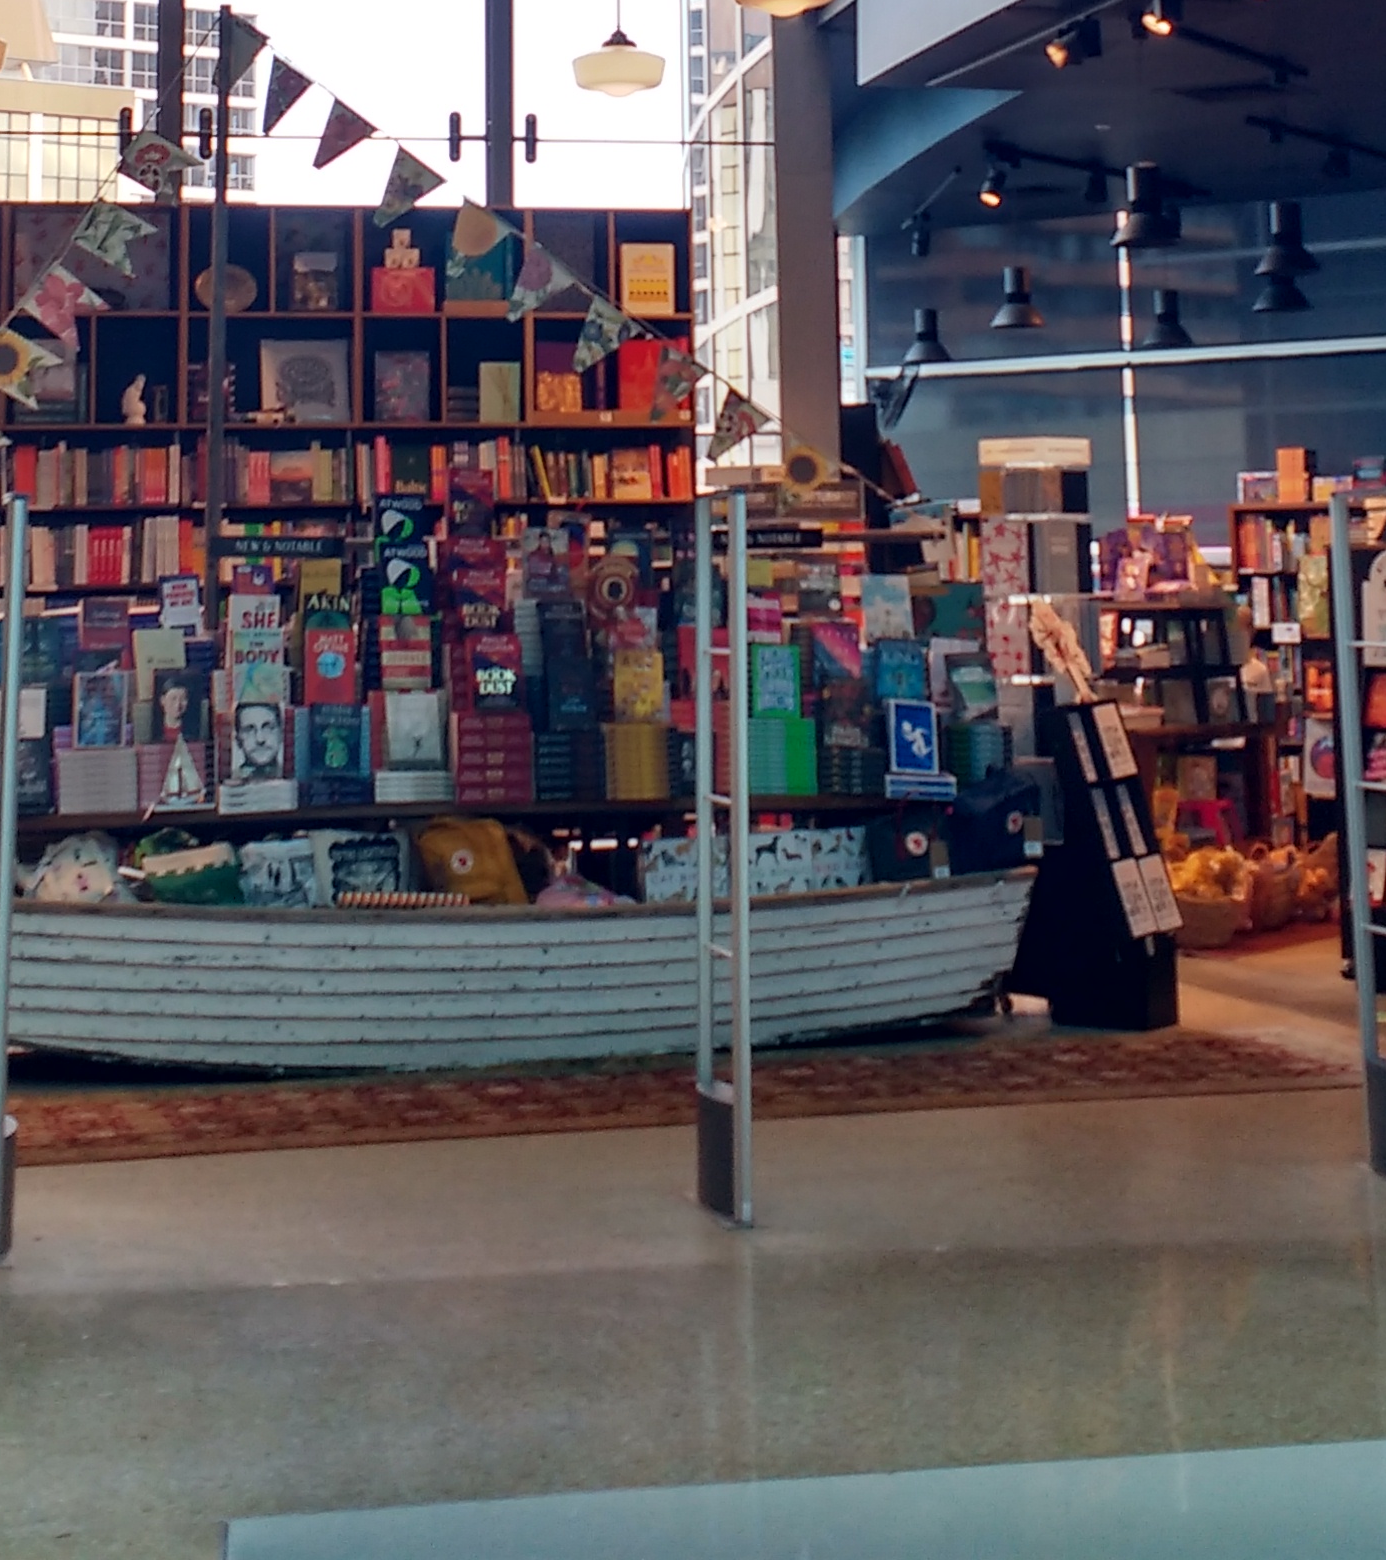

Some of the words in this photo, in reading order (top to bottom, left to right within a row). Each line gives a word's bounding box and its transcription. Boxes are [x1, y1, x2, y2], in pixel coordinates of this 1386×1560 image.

[379, 498, 424, 512] ATWOOD
[235, 540, 260, 551] NEW
[275, 540, 323, 552] NOTABLE
[384, 545, 428, 558] ATWOOD
[307, 594, 351, 610] AKIN
[241, 611, 276, 629] SHE
[235, 650, 280, 664] BODY
[476, 667, 517, 682] BOOK
[478, 681, 515, 695] DUST
